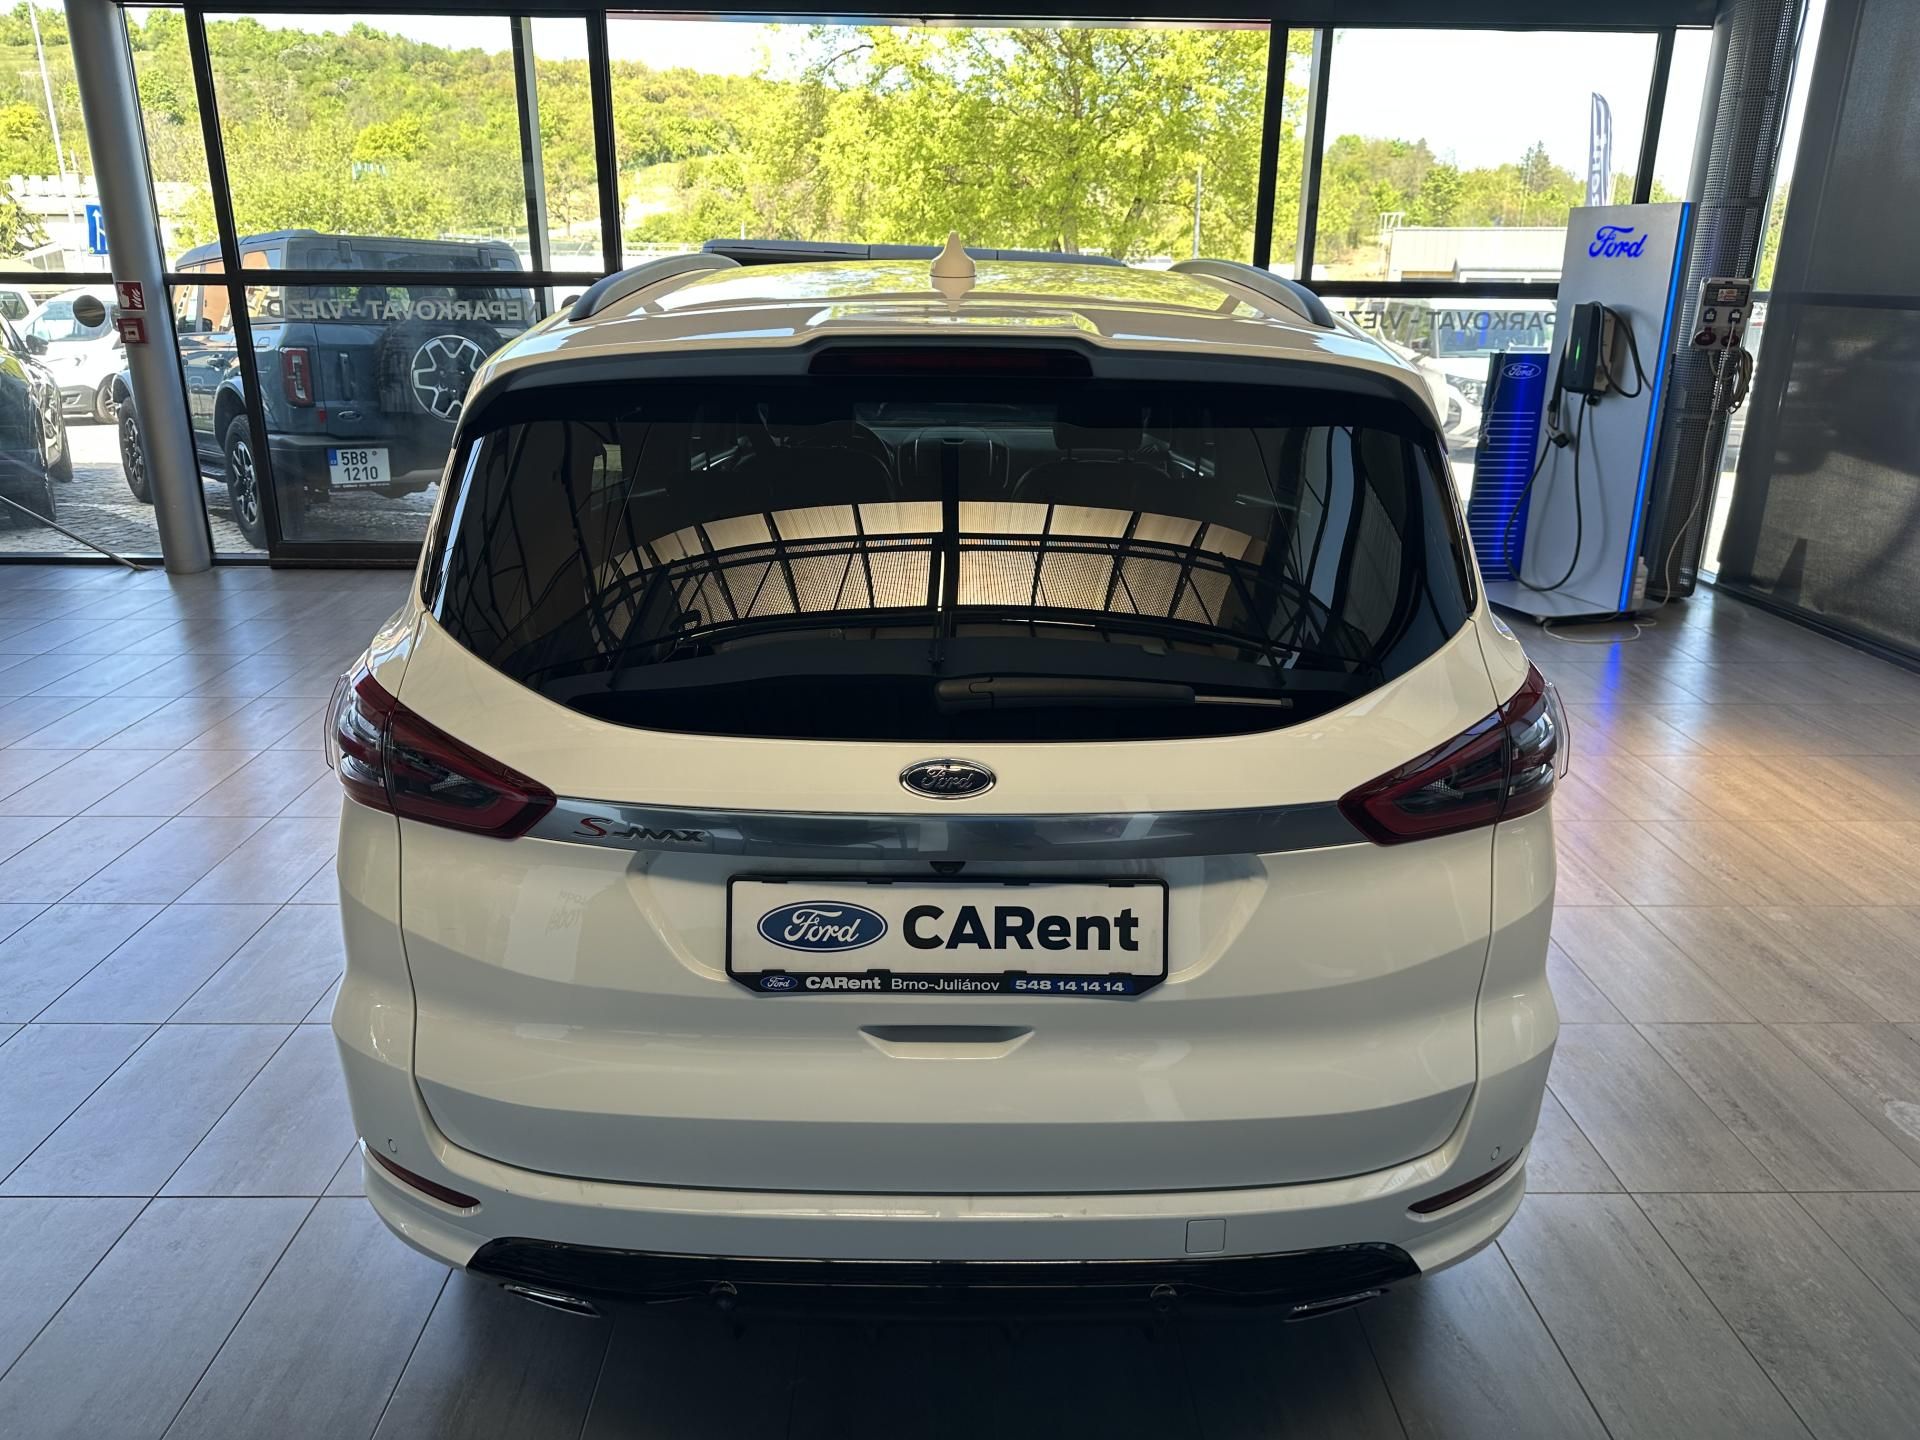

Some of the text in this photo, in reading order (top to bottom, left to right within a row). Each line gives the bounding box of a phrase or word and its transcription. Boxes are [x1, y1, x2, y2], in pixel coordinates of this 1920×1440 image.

[1588, 225, 1648, 258] Ford
[340, 450, 368, 466] 5B8
[343, 466, 379, 481] 1210
[783, 904, 1139, 952] Ford CARent
[805, 975, 881, 990] CARent
[891, 978, 1000, 992] Brno-Juliánov
[1014, 979, 1052, 991] 548
[1056, 980, 1078, 992] 14
[1080, 980, 1101, 992] 14
[1103, 981, 1125, 993] 14
